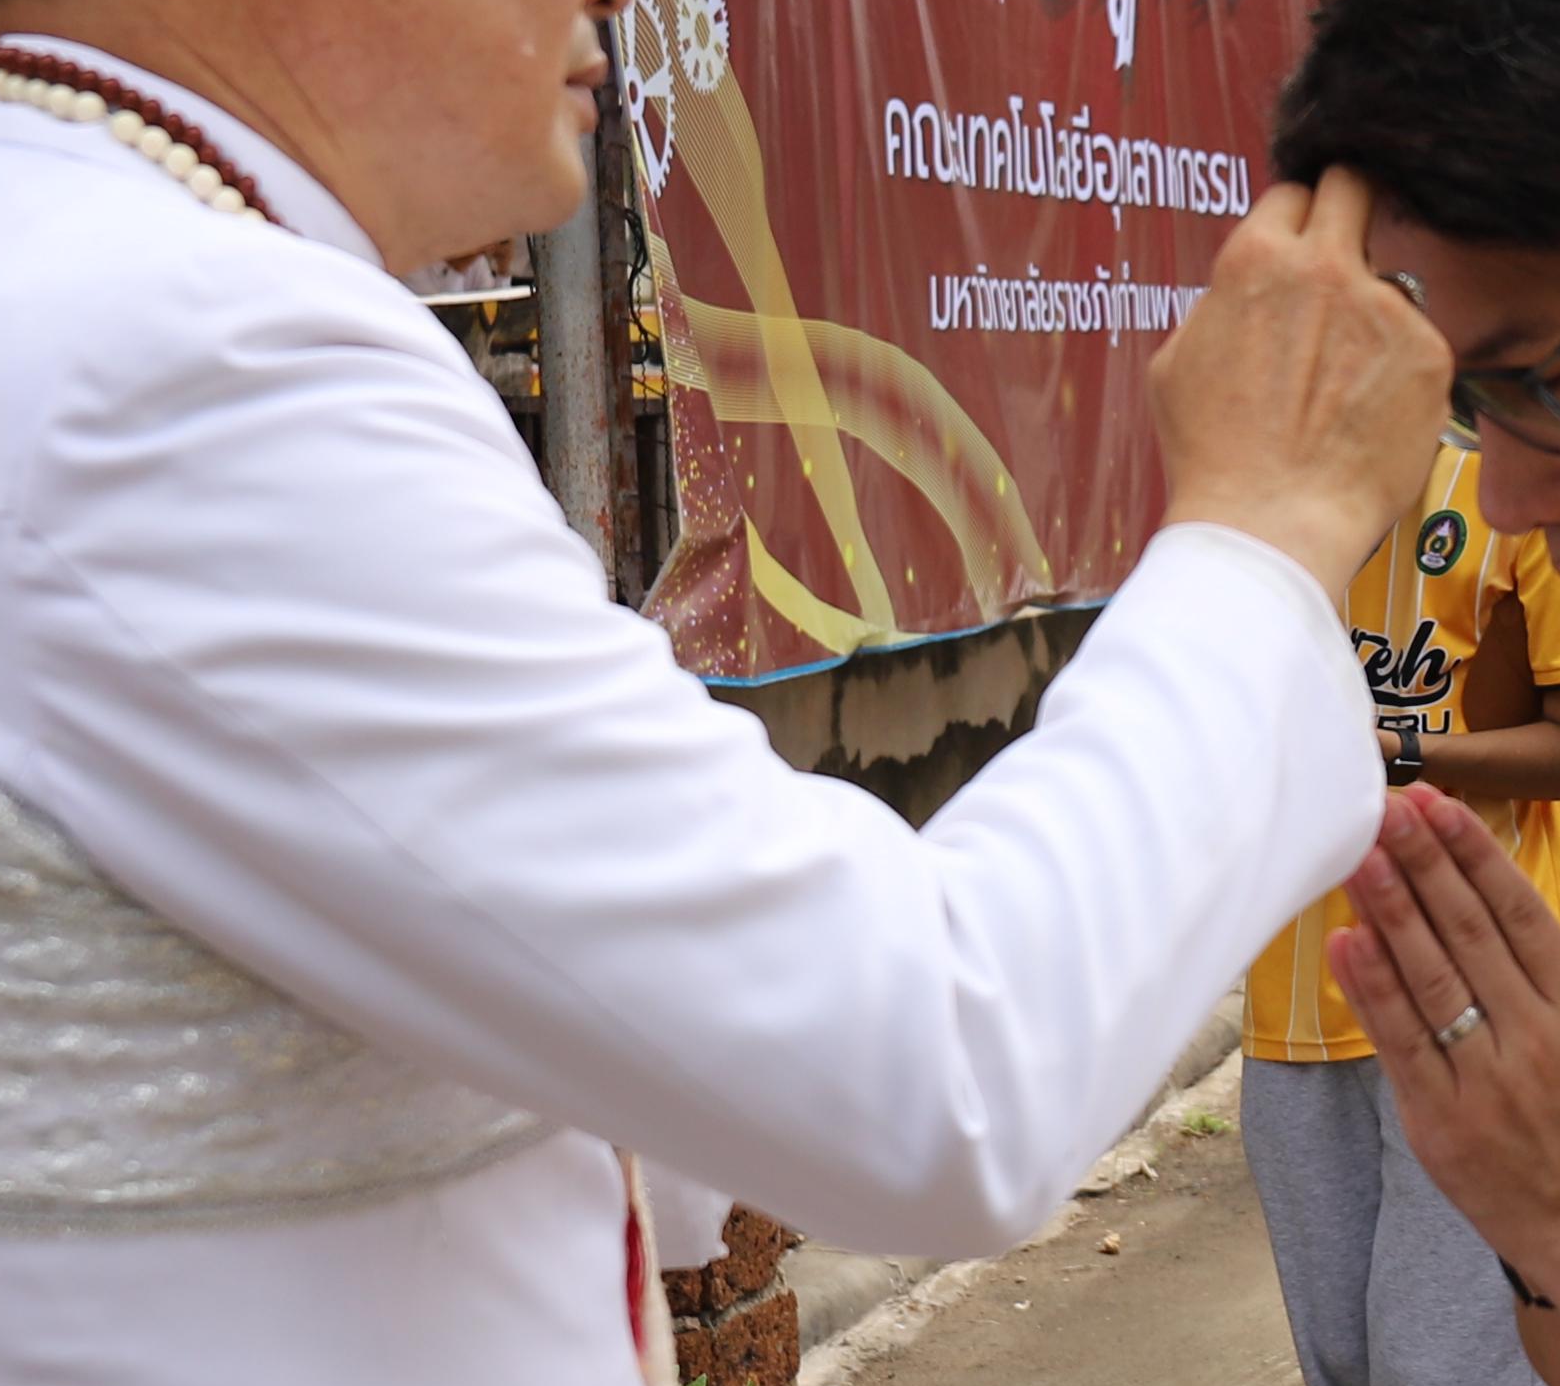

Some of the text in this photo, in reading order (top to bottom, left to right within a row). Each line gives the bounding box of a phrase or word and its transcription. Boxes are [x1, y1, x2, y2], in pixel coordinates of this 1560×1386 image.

[884, 94, 1251, 231] คณะเทคโนโลยีอุตสาหกรรม
